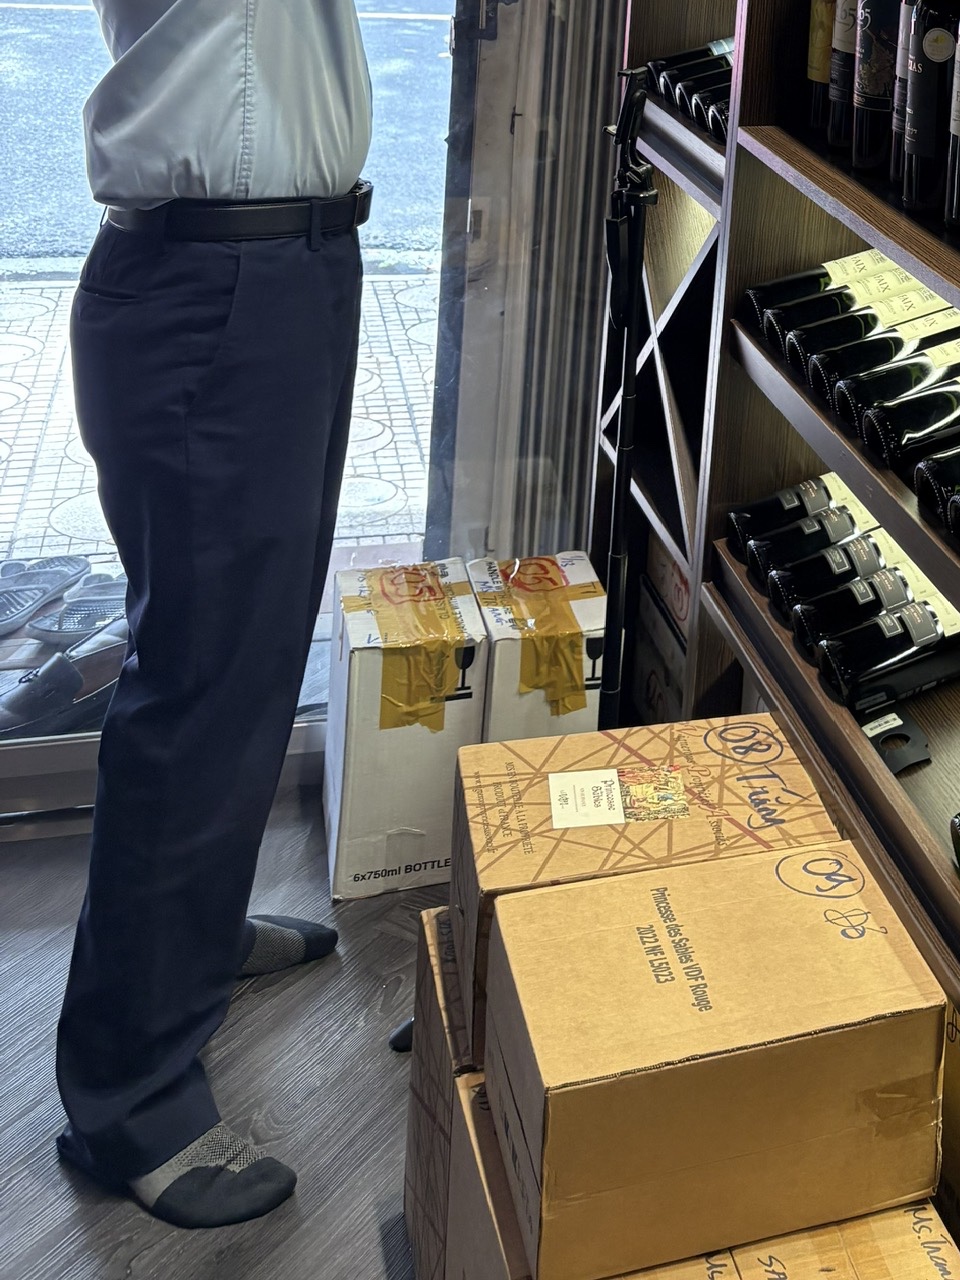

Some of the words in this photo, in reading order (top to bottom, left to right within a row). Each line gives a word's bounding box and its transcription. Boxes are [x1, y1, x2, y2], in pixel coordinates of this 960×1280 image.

[717, 724, 773, 757] 08
[353, 866, 401, 883] 6x750ml
[801, 857, 858, 893] 09
[650, 886, 678, 924] Princesse
[636, 924, 658, 946] 2022
[665, 921, 683, 939] des
[644, 943, 665, 958] NF
[671, 935, 695, 965] Sables
[648, 956, 676, 985] L5023
[682, 962, 705, 983] VDF
[688, 982, 713, 1014] Rouge
